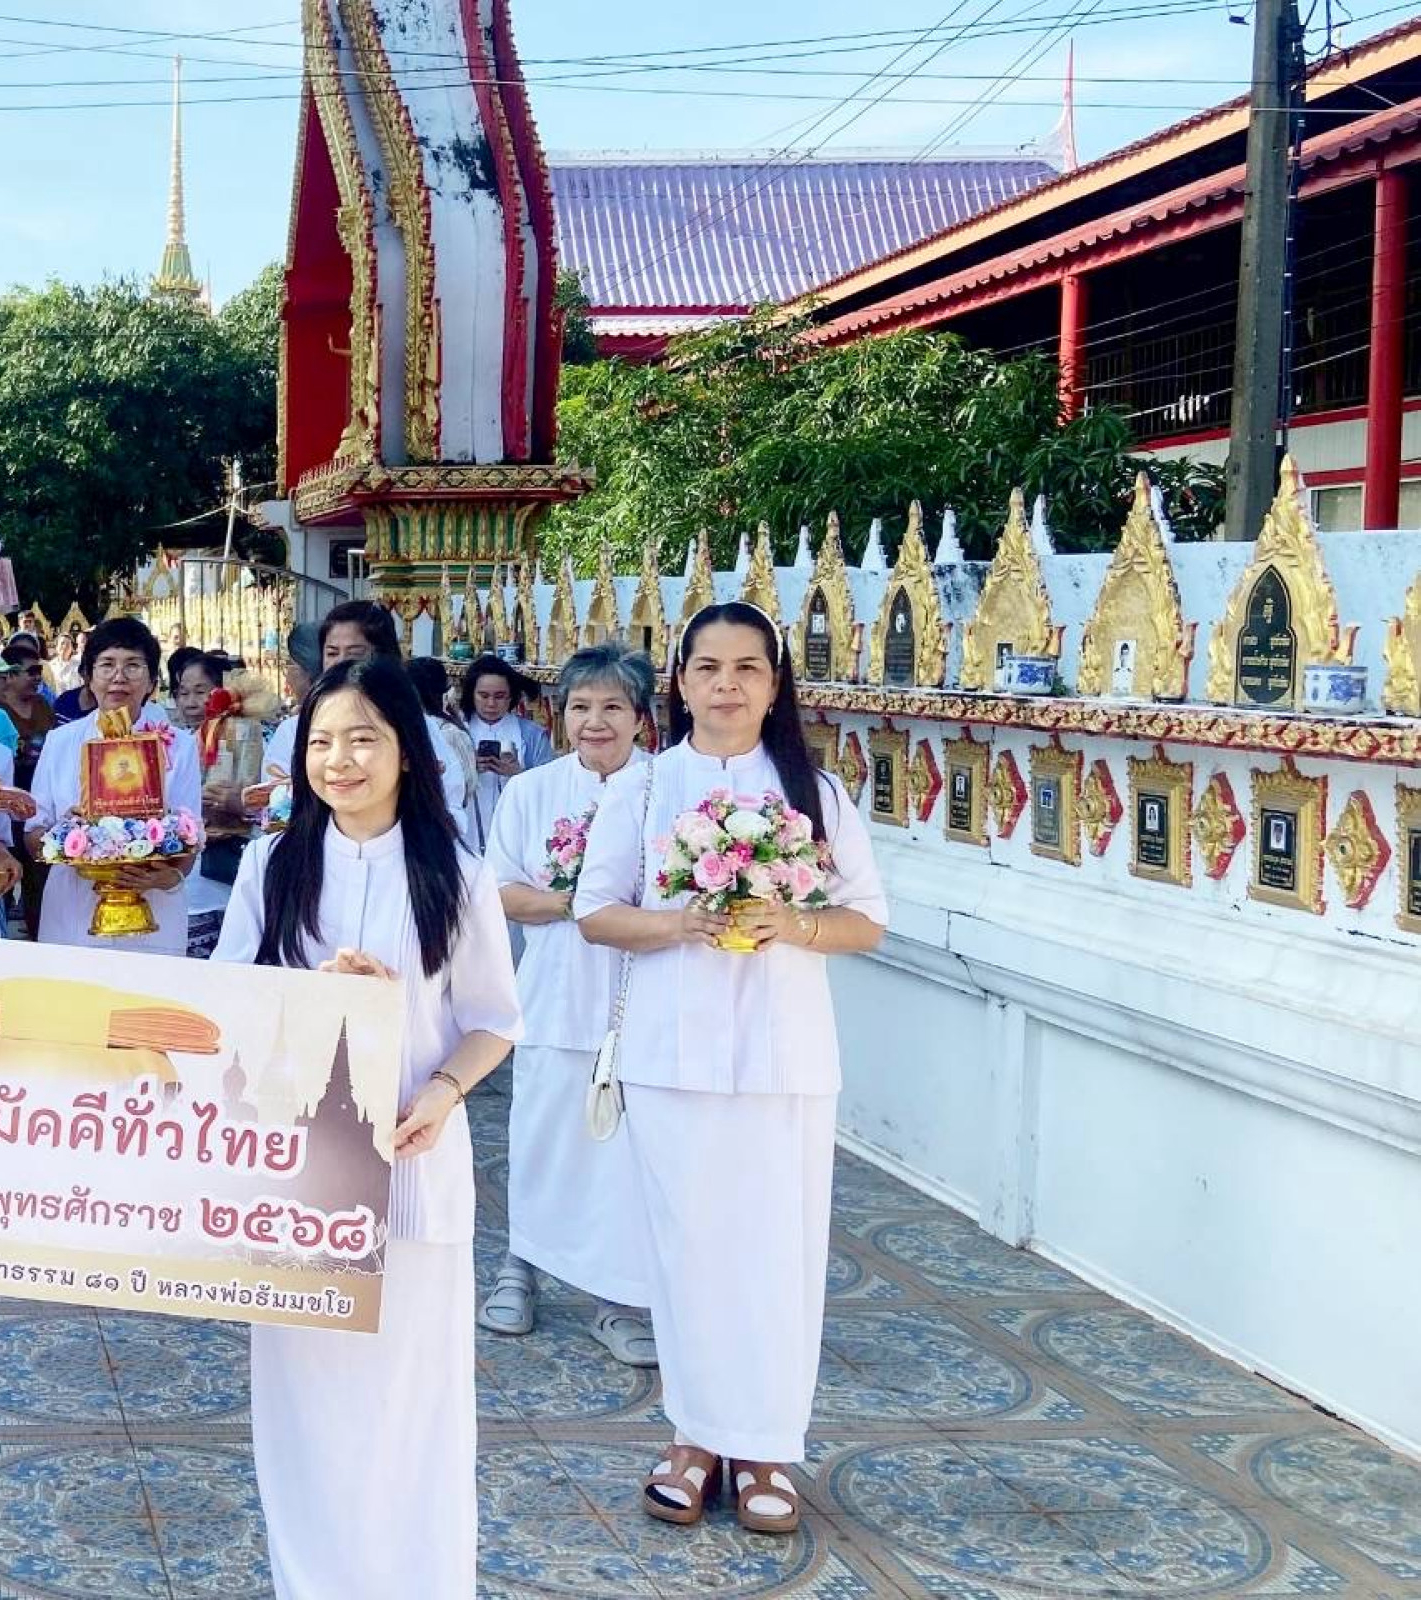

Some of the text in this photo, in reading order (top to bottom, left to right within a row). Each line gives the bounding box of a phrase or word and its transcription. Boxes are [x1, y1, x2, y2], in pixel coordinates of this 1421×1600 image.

[200, 1198, 367, 1252] ๒๕๖๘
[85, 1272, 120, 1292] ๘๑
[130, 1268, 148, 1294] ปี
[157, 1278, 352, 1316] หลวงพ่อธัมมชโย
